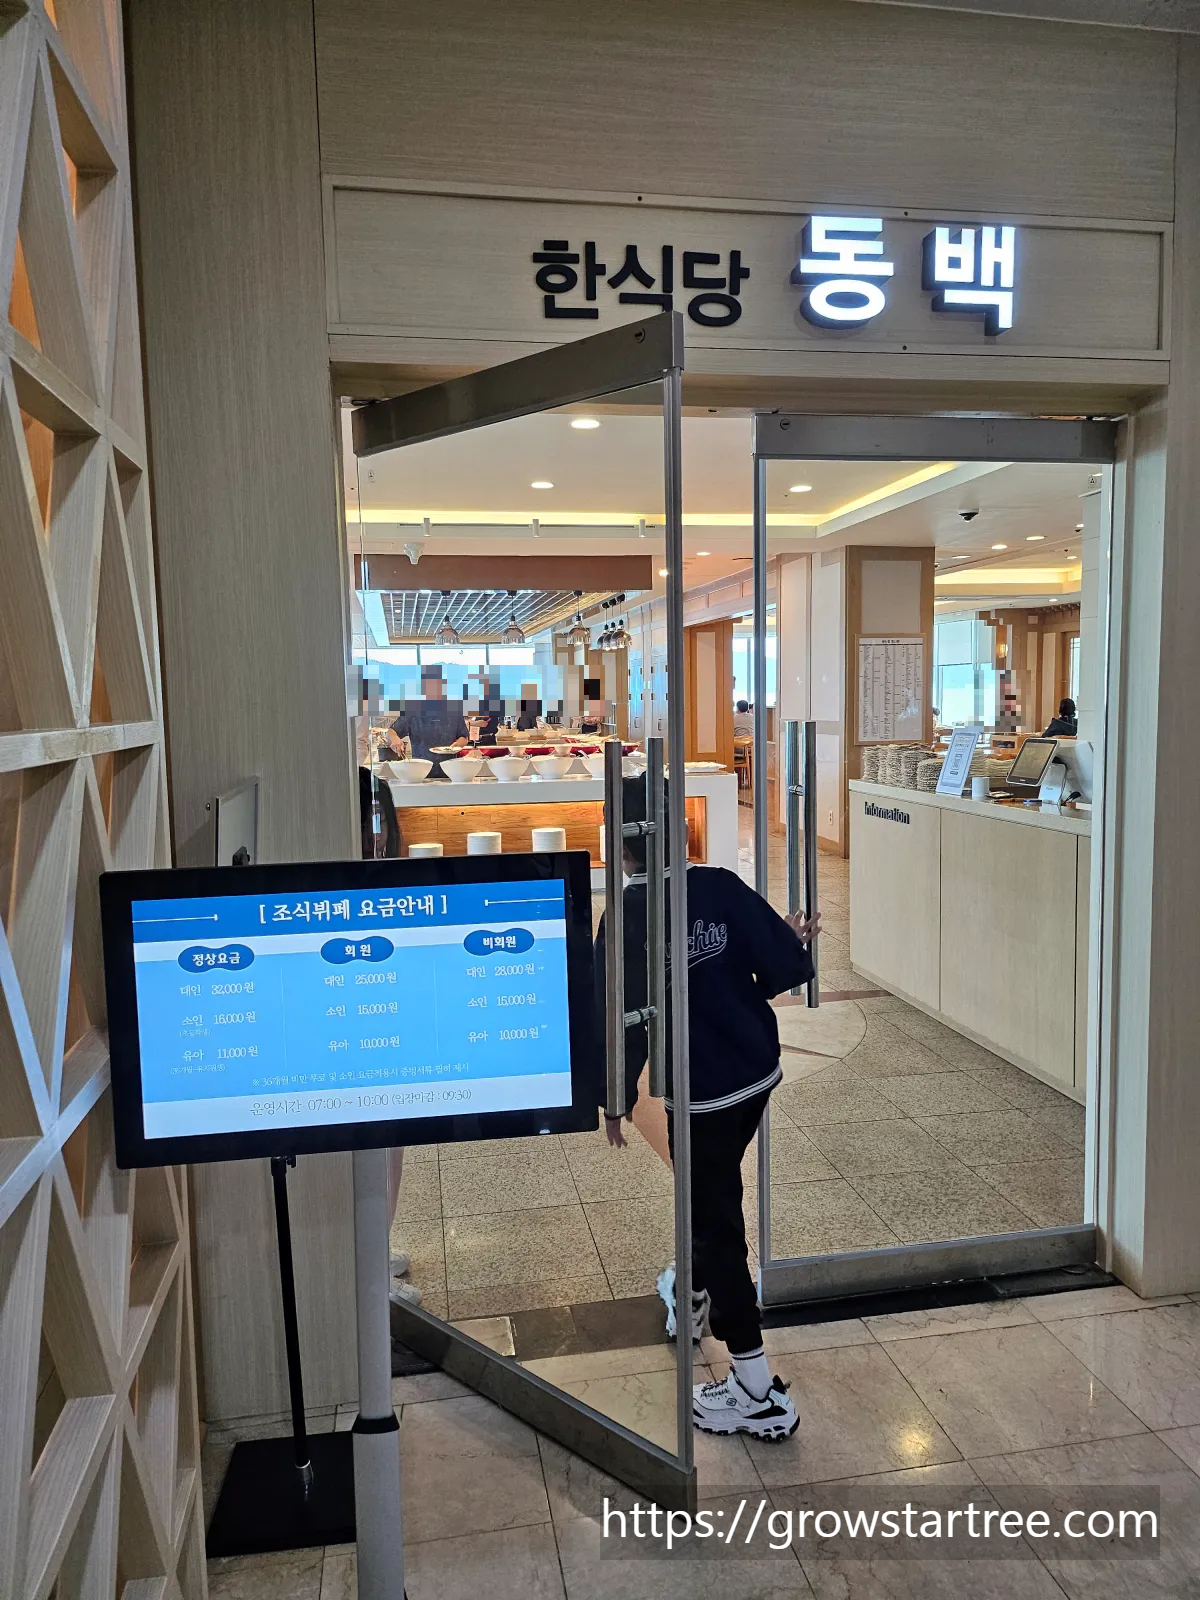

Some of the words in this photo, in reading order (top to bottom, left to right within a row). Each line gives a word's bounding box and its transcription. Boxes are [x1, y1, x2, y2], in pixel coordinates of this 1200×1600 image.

[532, 239, 750, 327] 한식당
[271, 899, 351, 922] 조식뷔페
[357, 895, 434, 918] 요금안내
[482, 935, 517, 949] 비회원
[192, 951, 241, 966] 정상요금
[465, 966, 487, 978] 대인
[323, 975, 345, 987] 대인
[180, 984, 201, 997] 대인
[467, 996, 488, 1008] 소인
[325, 1004, 346, 1017] 소인
[182, 1014, 203, 1027] 소인
[468, 1031, 489, 1043] 유아
[328, 1040, 349, 1052] 유아
[182, 1049, 204, 1062] 유아
[291, 1074, 309, 1085] 미만
[309, 1072, 327, 1084] 무료
[339, 1069, 356, 1081] 소인
[453, 1062, 470, 1074] 제시
[249, 1098, 302, 1117] 운영시간
[308, 1097, 342, 1112] 07:00
[357, 1094, 390, 1108] 10:00
